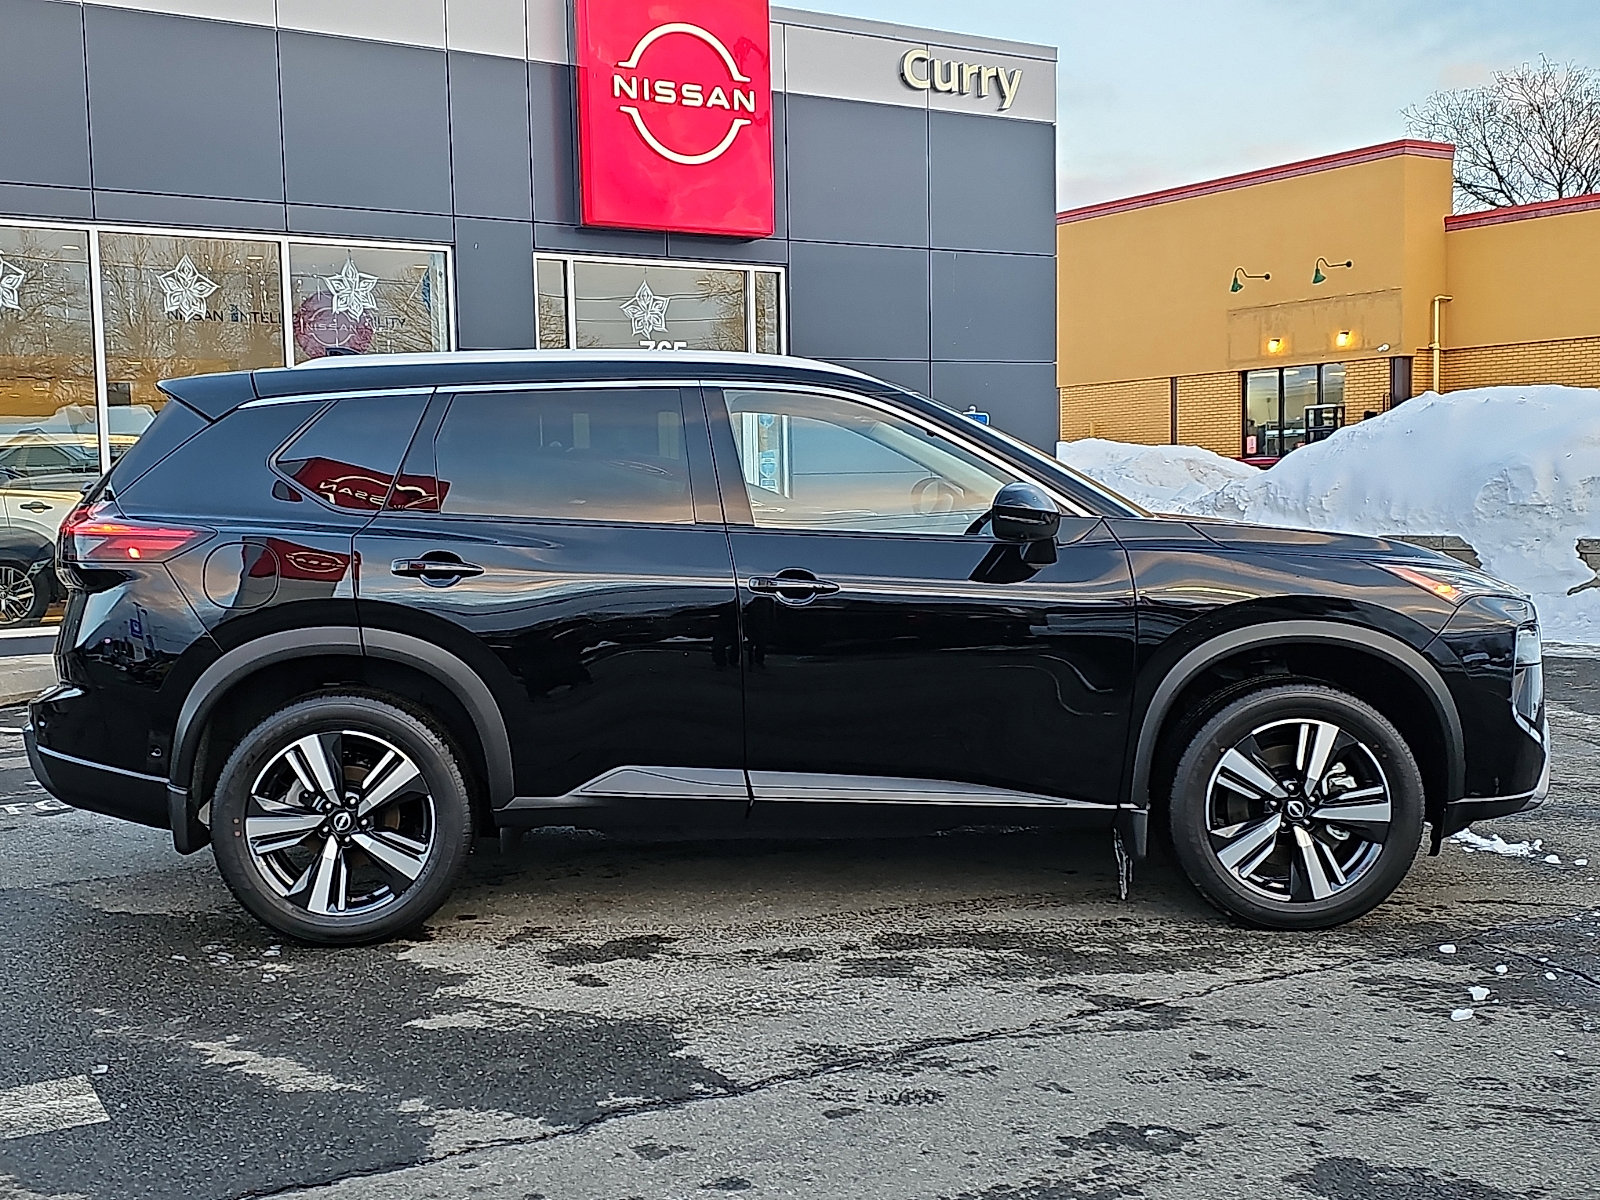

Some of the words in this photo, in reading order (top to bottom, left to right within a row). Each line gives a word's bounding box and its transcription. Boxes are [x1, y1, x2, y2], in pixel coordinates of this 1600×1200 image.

[613, 74, 755, 113] NISSAN
[901, 48, 1022, 111] Curry
[306, 323, 357, 332] NISSAN
